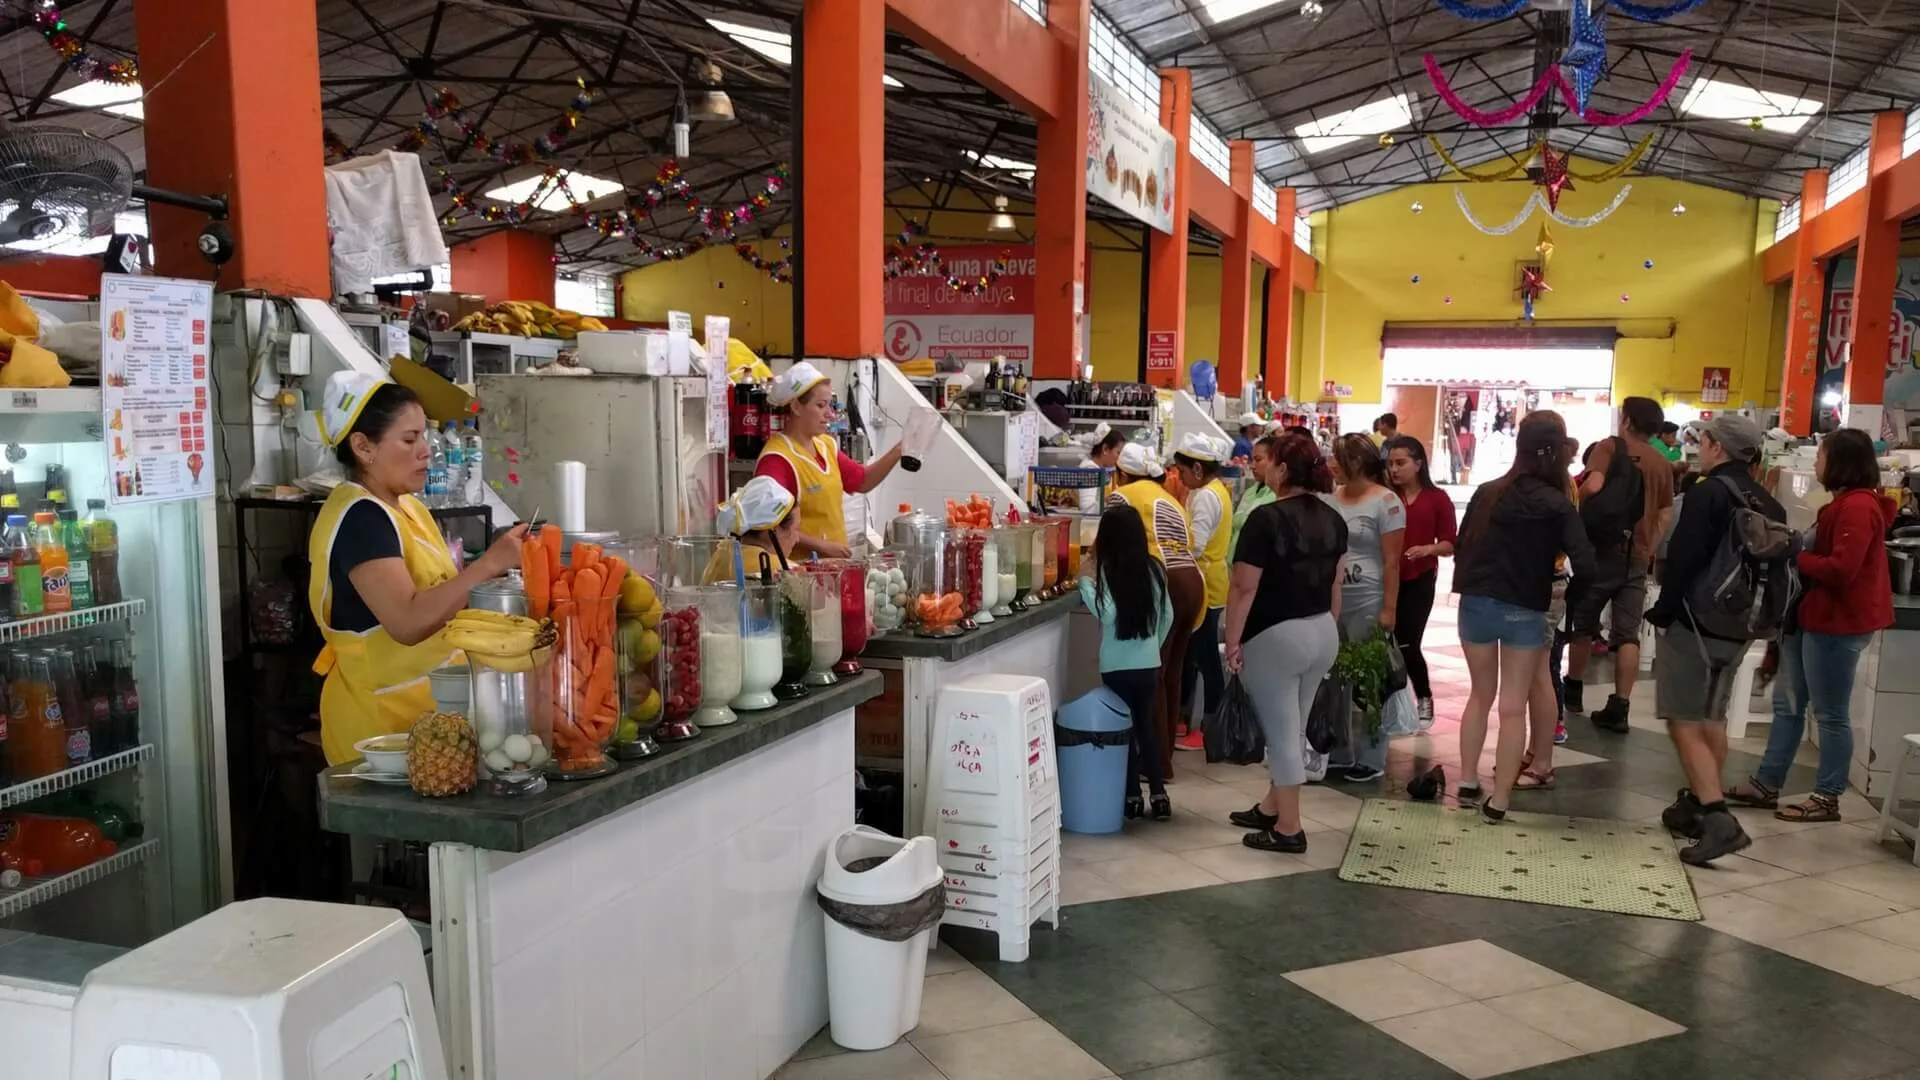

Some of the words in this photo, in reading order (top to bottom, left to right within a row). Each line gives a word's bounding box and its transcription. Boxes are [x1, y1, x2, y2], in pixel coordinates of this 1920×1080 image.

[949, 259, 981, 276] una
[898, 281, 930, 303] final
[934, 281, 956, 303] de
[938, 323, 1017, 344] Ecuador
